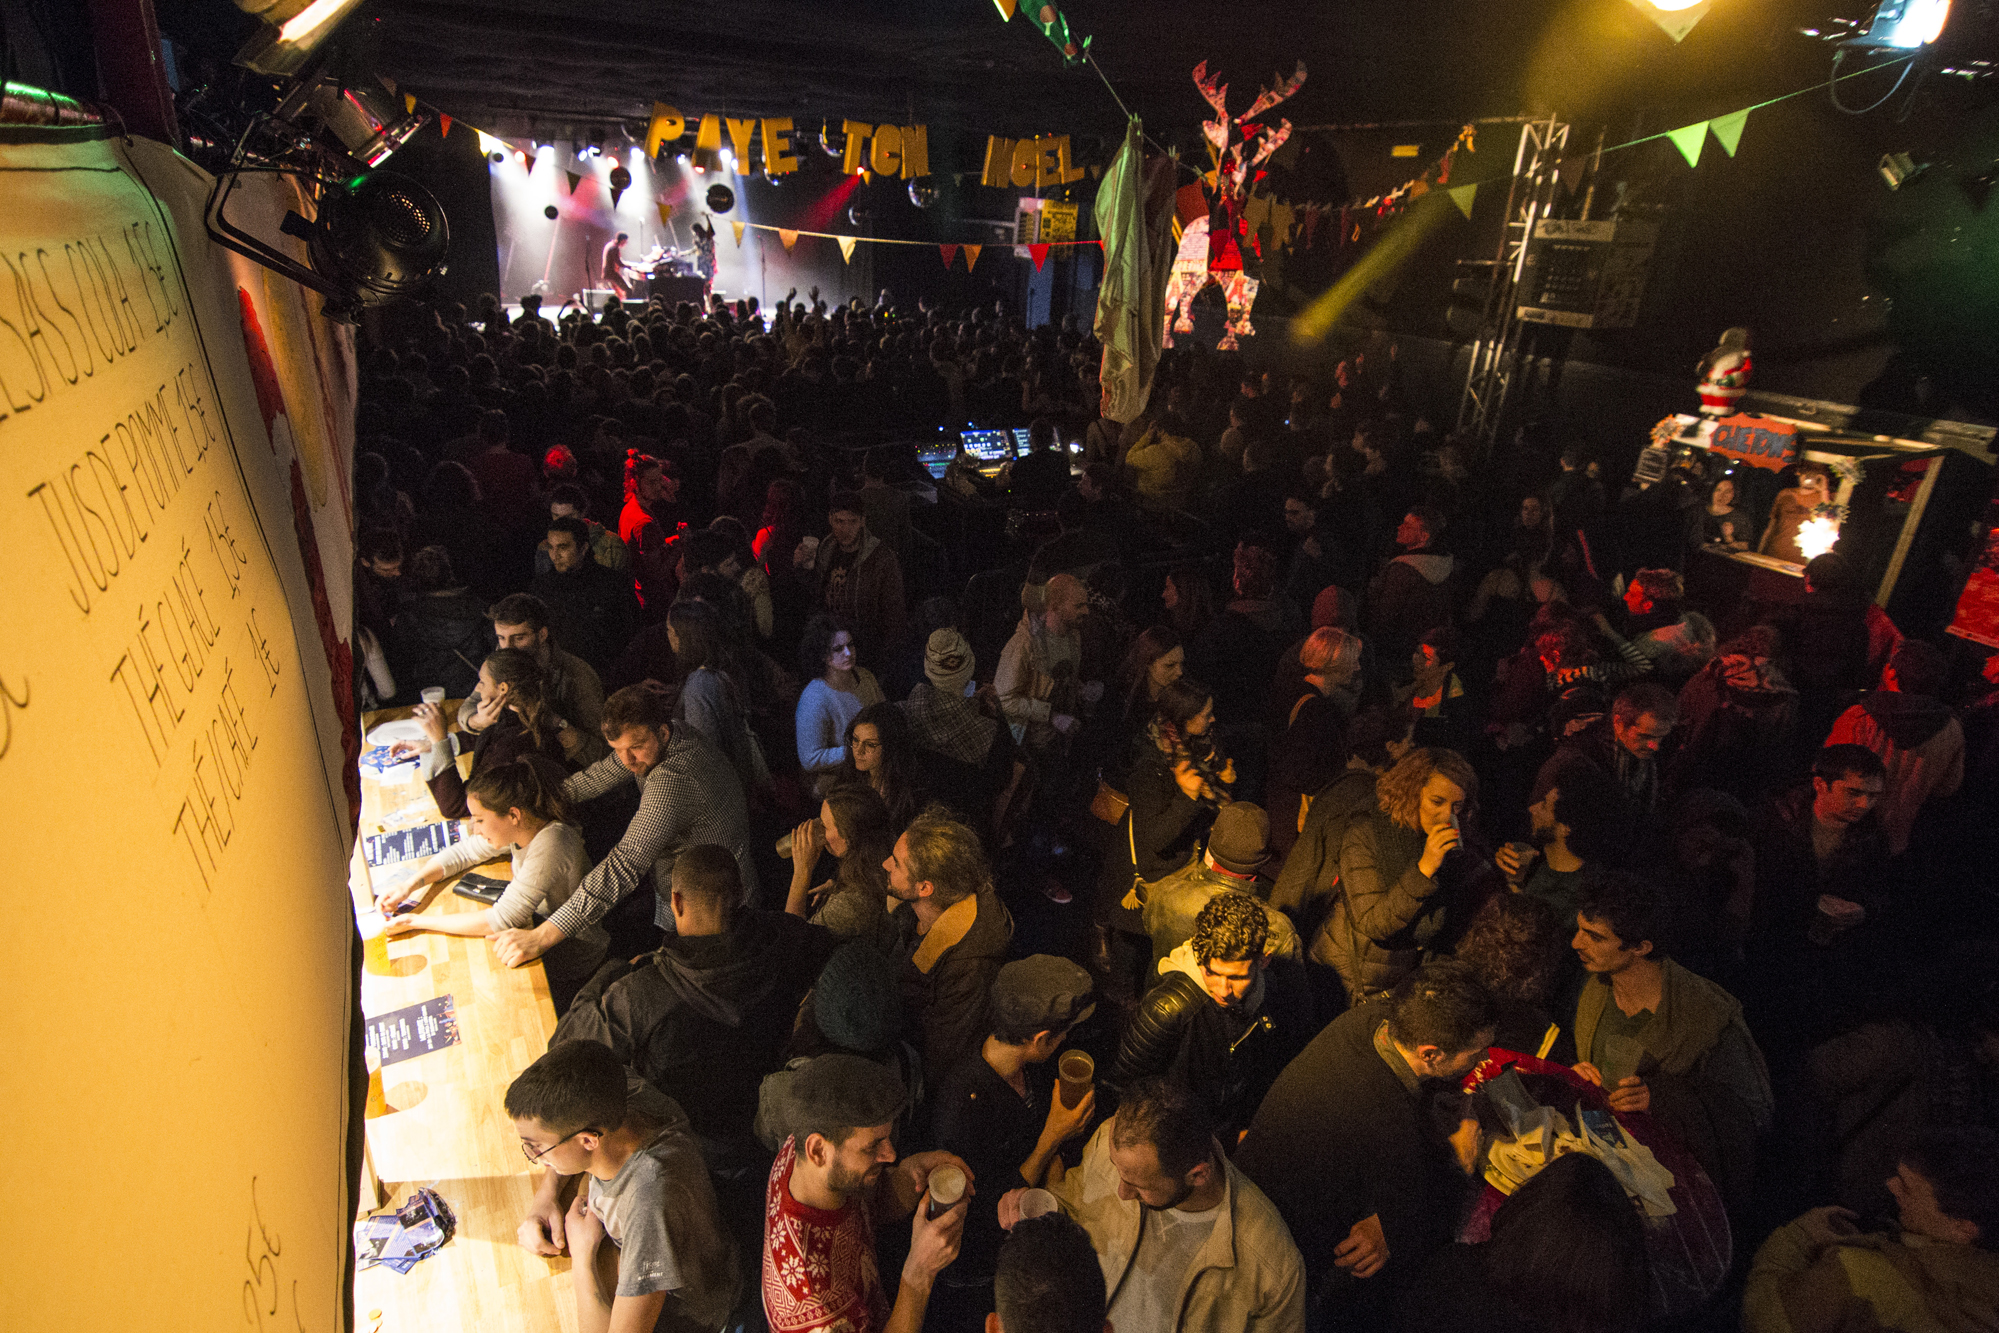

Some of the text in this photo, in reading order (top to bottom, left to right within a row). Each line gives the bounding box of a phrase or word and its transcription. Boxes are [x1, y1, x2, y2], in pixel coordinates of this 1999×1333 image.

[644, 101, 798, 176] PAYE
[843, 118, 931, 180] TON
[65, 236, 145, 364] COLA
[86, 433, 148, 560] DE
[114, 384, 194, 526] POMME
[27, 478, 120, 616] JUS
[110, 604, 186, 769] THÉ
[157, 535, 221, 693] GLACÉ
